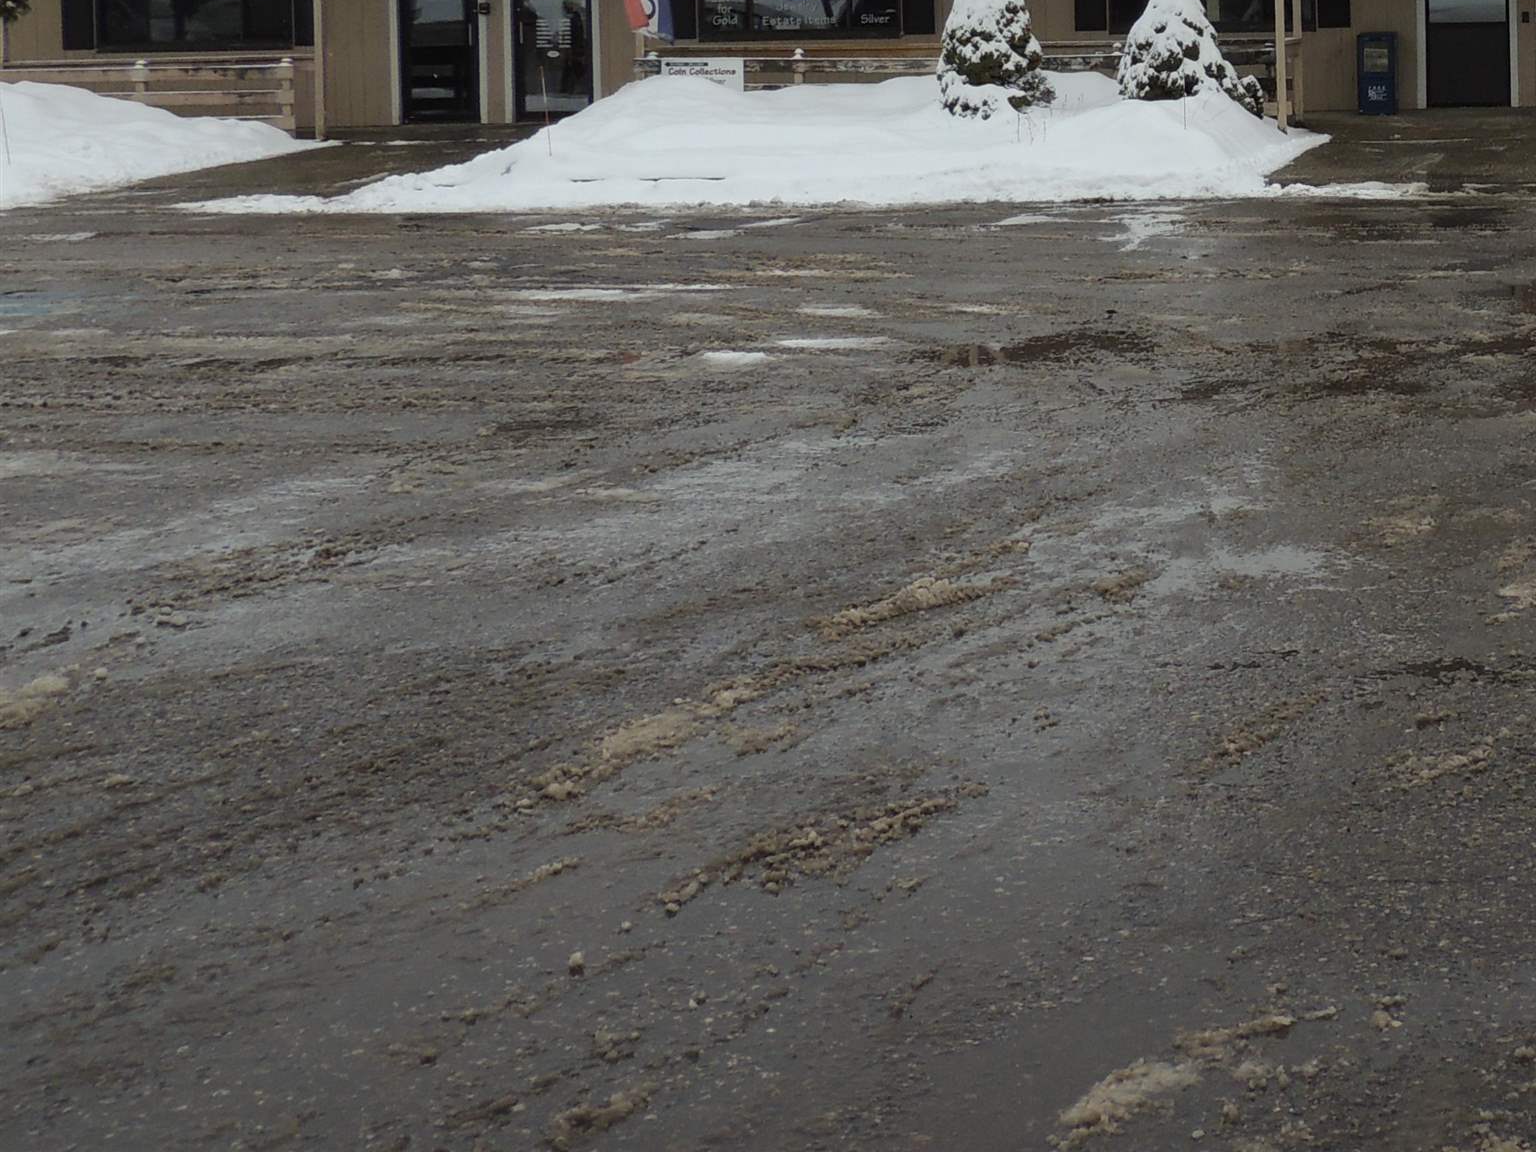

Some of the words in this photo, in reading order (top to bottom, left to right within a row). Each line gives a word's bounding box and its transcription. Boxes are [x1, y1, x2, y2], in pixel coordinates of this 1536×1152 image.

[717, 3, 734, 14] for
[712, 15, 739, 26] Gold
[762, 16, 801, 26] Estate
[860, 15, 891, 25] Silver
[668, 67, 687, 76] Coin
[689, 67, 737, 76] Collections
